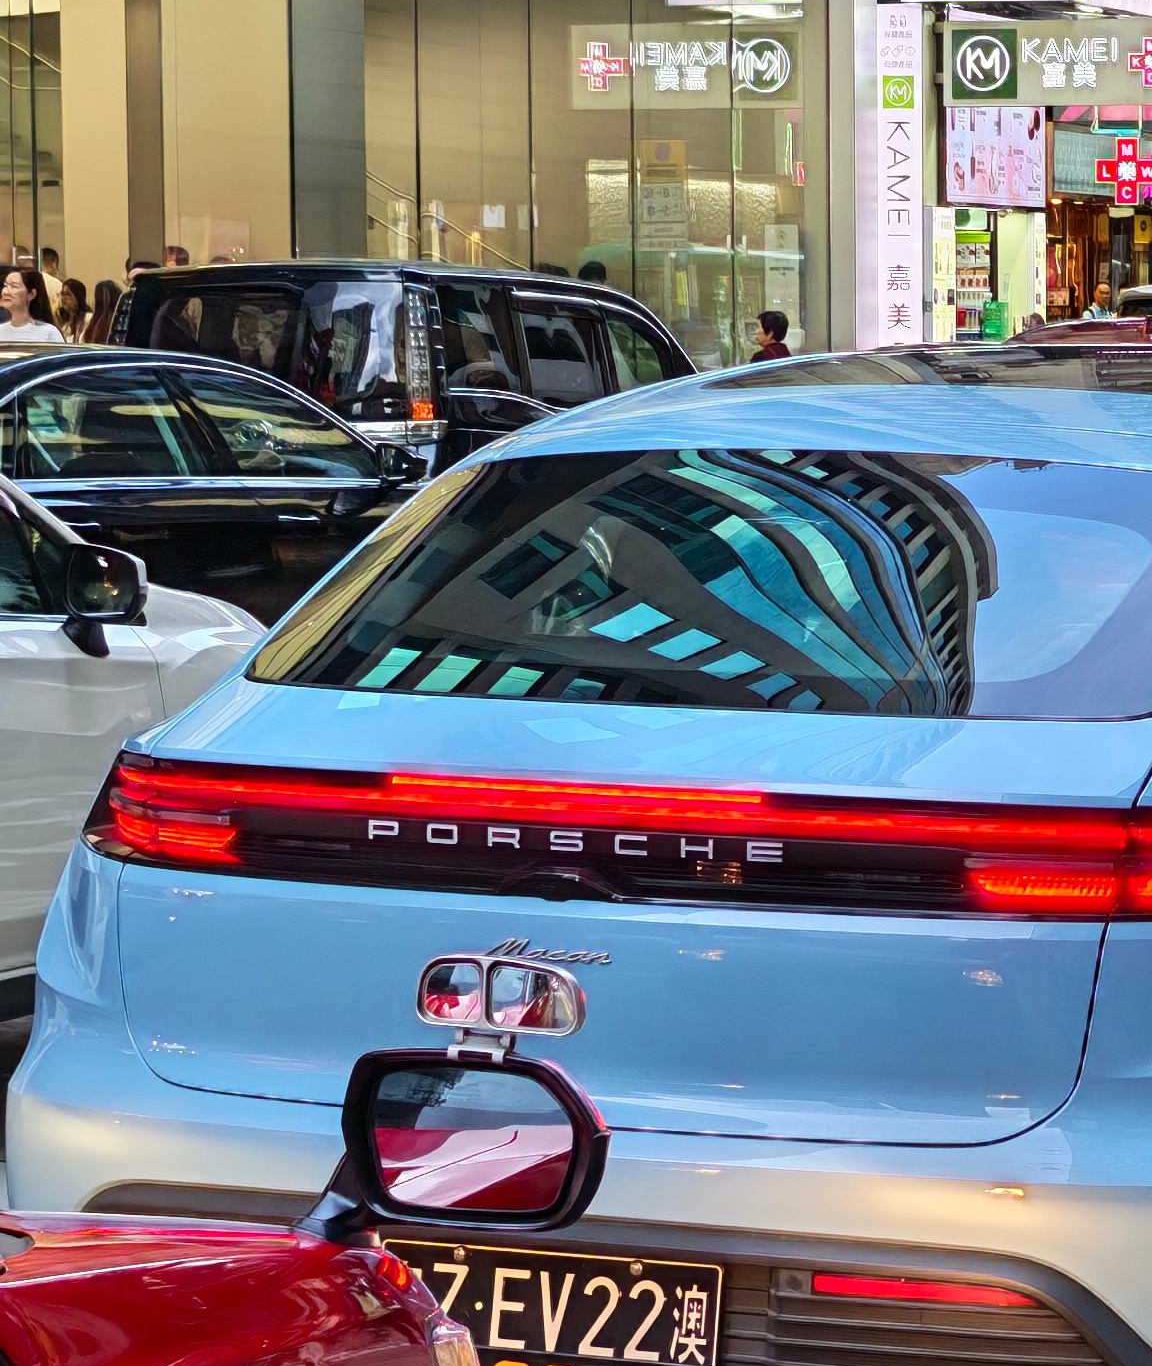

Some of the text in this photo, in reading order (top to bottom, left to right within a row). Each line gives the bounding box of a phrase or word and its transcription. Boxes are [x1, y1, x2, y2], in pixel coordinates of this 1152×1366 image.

[1020, 37, 1119, 63] KAMEI
[1042, 62, 1097, 89] 嘉美
[886, 121, 911, 237] KAMEI
[886, 264, 912, 330] 嘉美
[367, 818, 785, 864] PORSCHE
[485, 937, 612, 966] Macan
